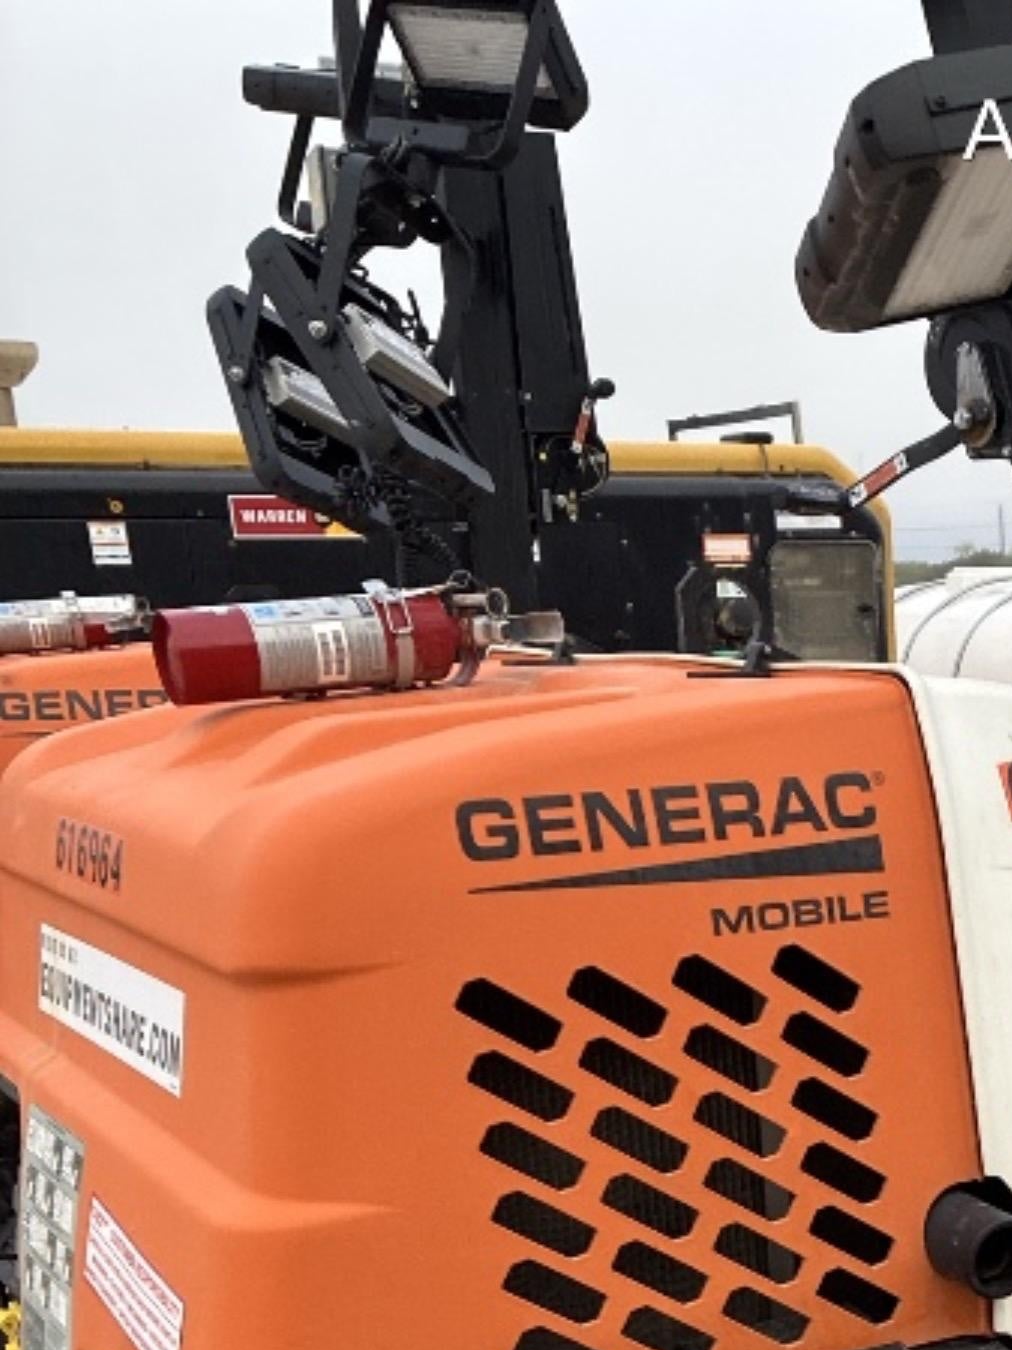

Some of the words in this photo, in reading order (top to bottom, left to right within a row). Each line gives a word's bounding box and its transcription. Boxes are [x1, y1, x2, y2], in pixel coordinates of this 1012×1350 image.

[455, 770, 878, 862] GENERAC
[56, 817, 123, 892] 616964
[710, 889, 890, 937] MOBILE
